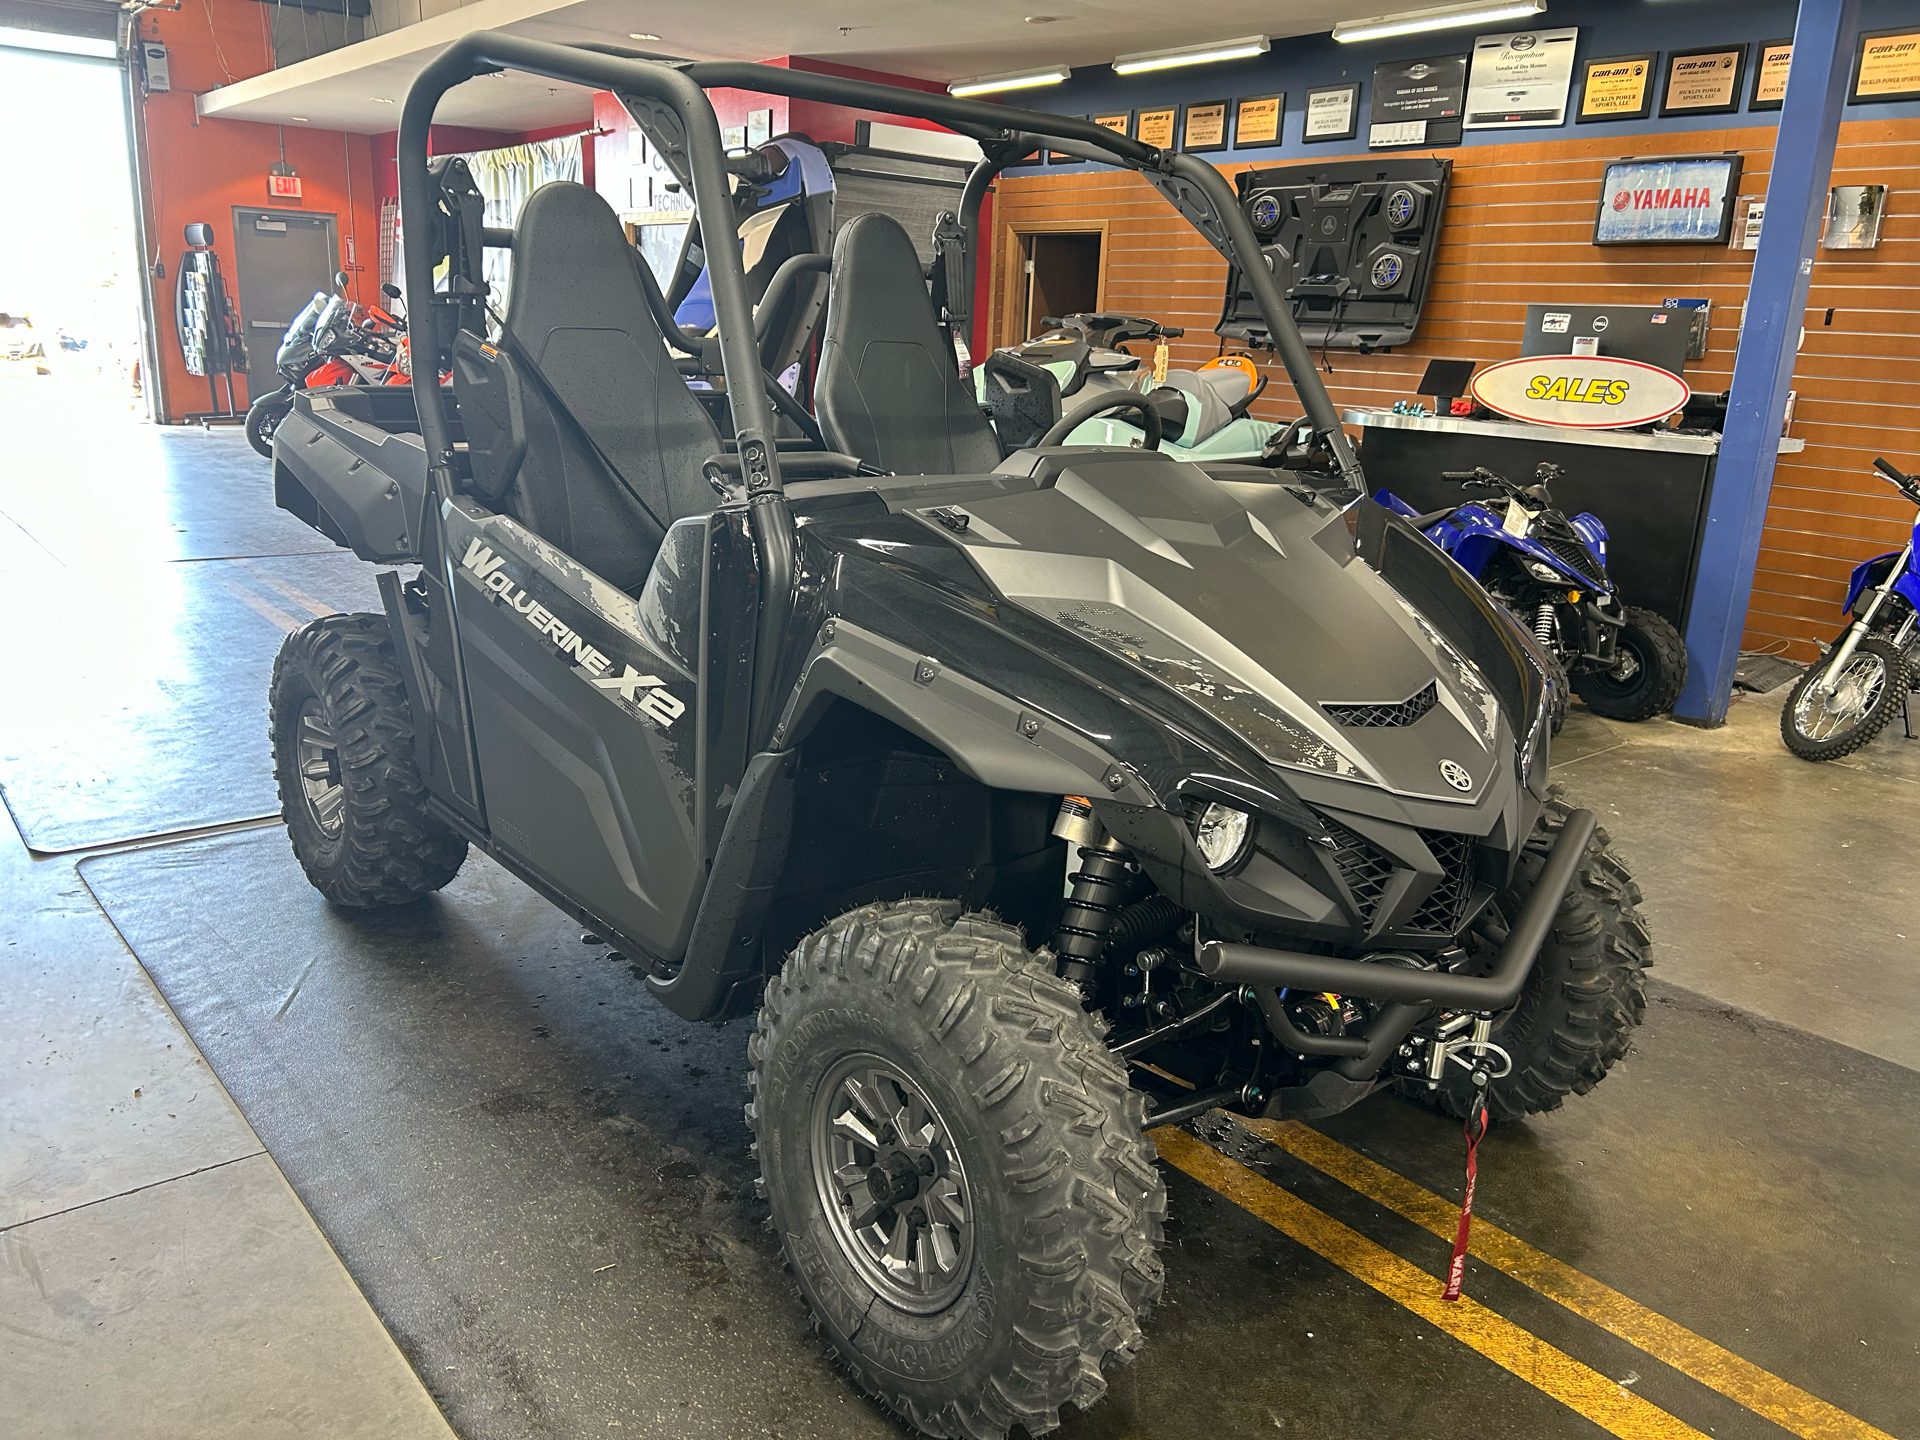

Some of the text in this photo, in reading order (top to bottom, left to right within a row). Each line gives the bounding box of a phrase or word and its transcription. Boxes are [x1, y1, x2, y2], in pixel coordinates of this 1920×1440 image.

[1500, 51, 1545, 62] Recognition
[1868, 43, 1917, 54] can-am
[1592, 68, 1629, 77] can-am
[1676, 60, 1717, 70] can-am
[275, 178, 298, 194] EXIT
[1633, 188, 1710, 210] YAMAHA
[1526, 375, 1629, 405] SALES
[461, 536, 686, 727] WOLVERINE X2
[1446, 1254, 1464, 1295] WARN
